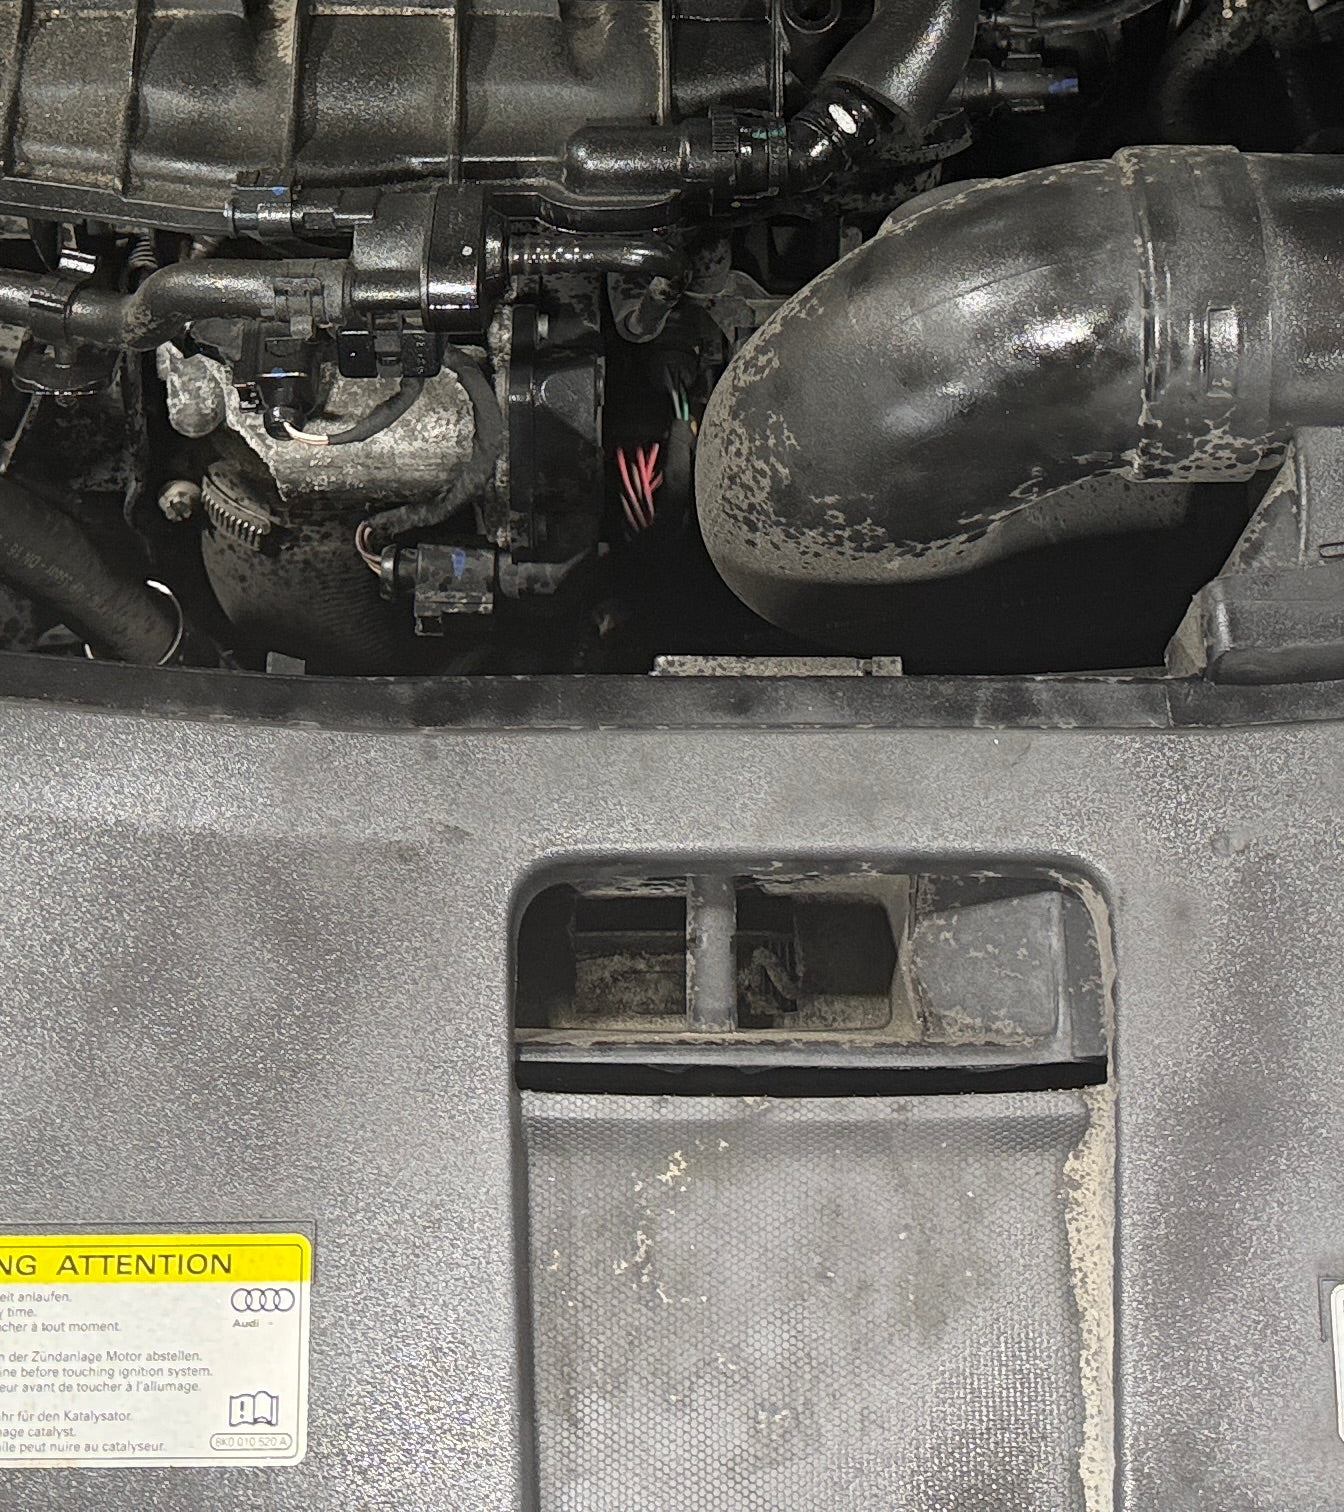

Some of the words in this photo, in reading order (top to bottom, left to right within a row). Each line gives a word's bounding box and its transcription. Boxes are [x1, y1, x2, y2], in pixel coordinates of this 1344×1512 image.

[54, 1254, 234, 1276] ATTENTION
[18, 1292, 72, 1302] anlaufen.
[7, 1307, 37, 1318] time.
[42, 1322, 65, 1332] tout
[68, 1322, 121, 1332] moment.
[232, 1319, 259, 1328] Audi
[9, 1352, 28, 1362] der
[31, 1351, 102, 1364] Zündanlage
[106, 1351, 142, 1362] Motor
[146, 1351, 202, 1362] abstellen.
[21, 1367, 58, 1377] before
[62, 1367, 114, 1379] touching
[119, 1367, 163, 1379] ignition
[168, 1367, 212, 1378] system.
[23, 1382, 55, 1392] avant
[58, 1382, 73, 1392] de
[77, 1382, 123, 1392] toucher
[17, 1410, 34, 1422] für
[38, 1410, 60, 1422] den
[64, 1410, 132, 1423] Katalysator.
[28, 1426, 76, 1438] catalyst.
[20, 1442, 46, 1453] peut
[50, 1441, 80, 1452] nuire
[84, 1442, 97, 1452] au
[102, 1441, 165, 1454] catalyseur.
